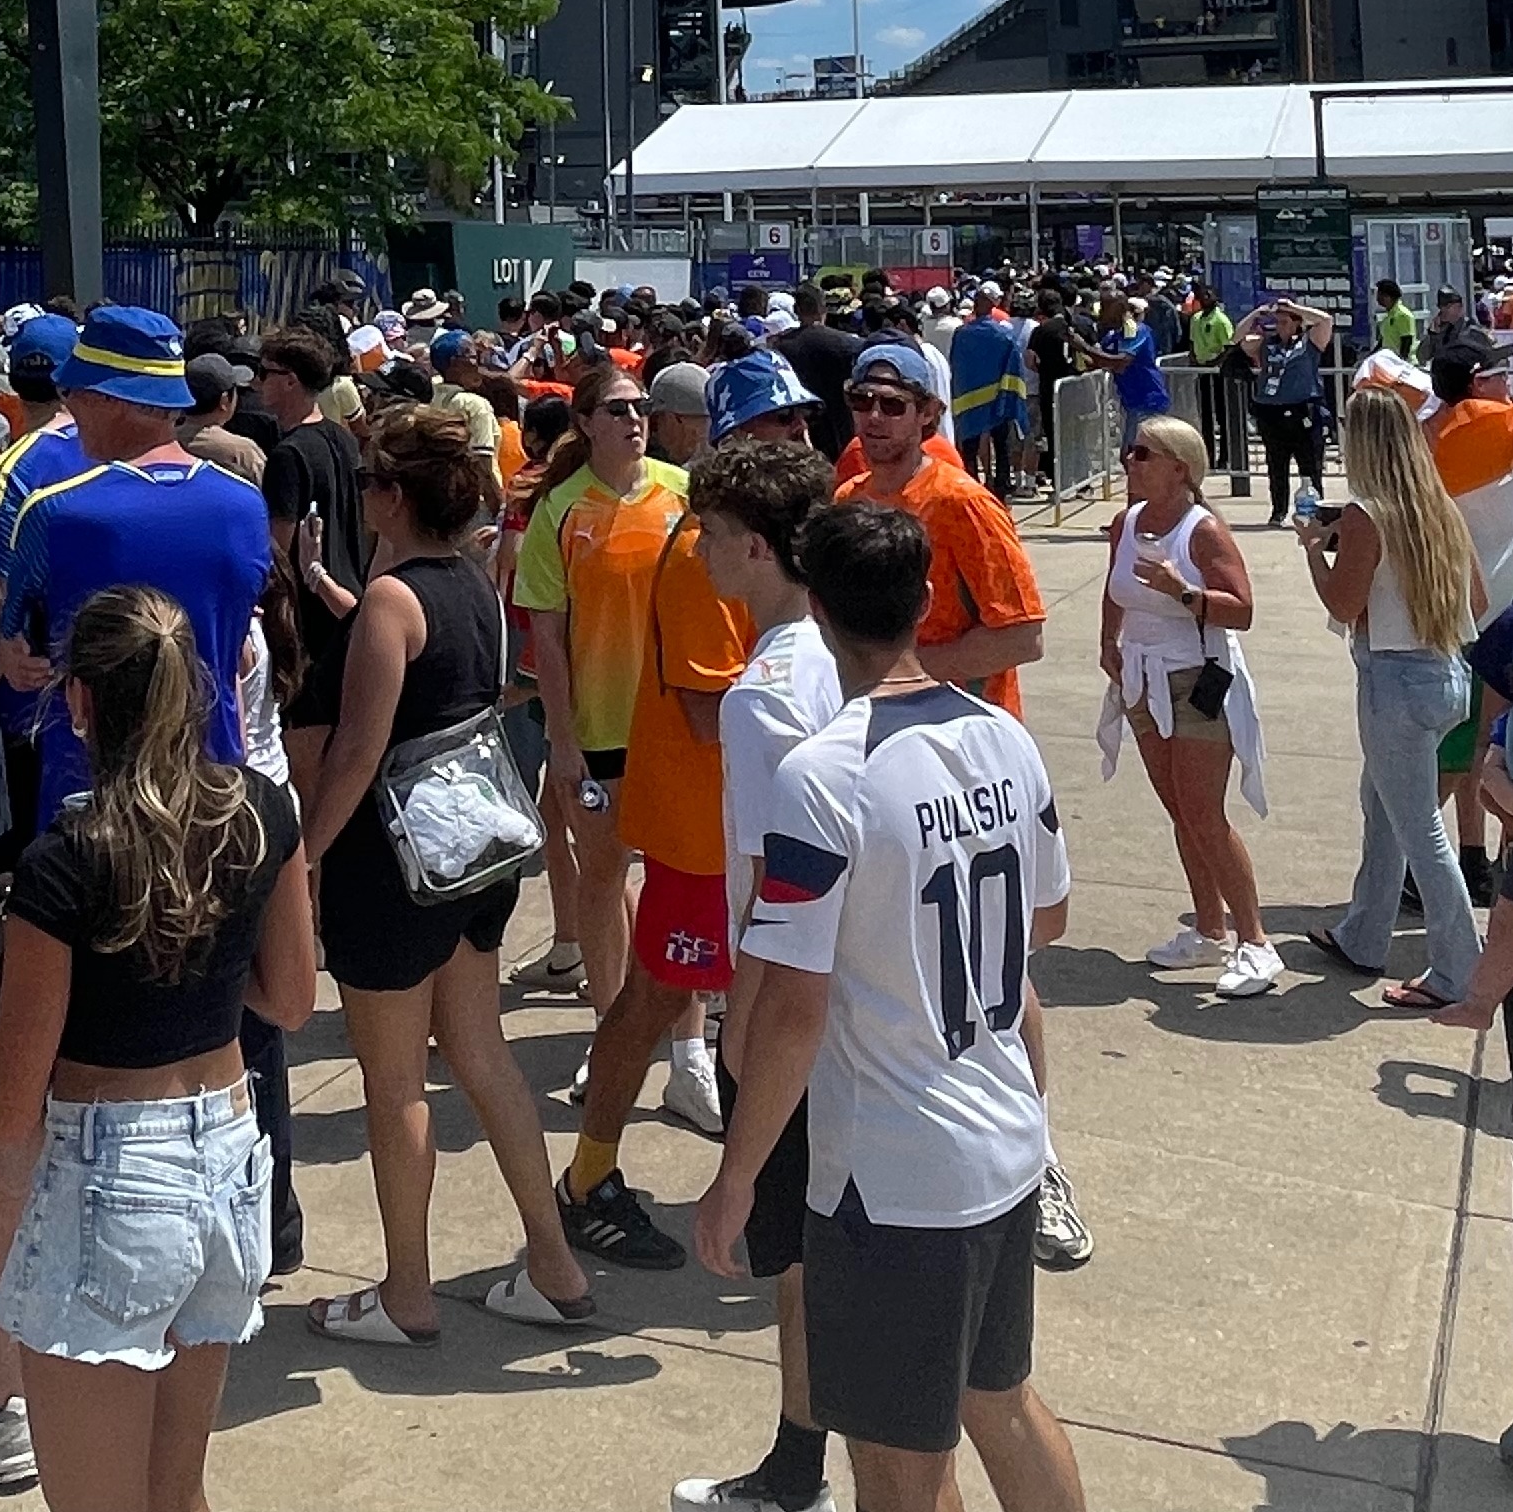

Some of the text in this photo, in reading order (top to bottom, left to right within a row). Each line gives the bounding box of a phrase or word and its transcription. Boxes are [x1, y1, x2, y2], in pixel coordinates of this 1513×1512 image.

[769, 226, 781, 245] 6
[929, 232, 941, 251] 6
[493, 258, 521, 284] LOT
[914, 779, 1018, 849] PULISIC
[921, 842, 1026, 1061] 10
